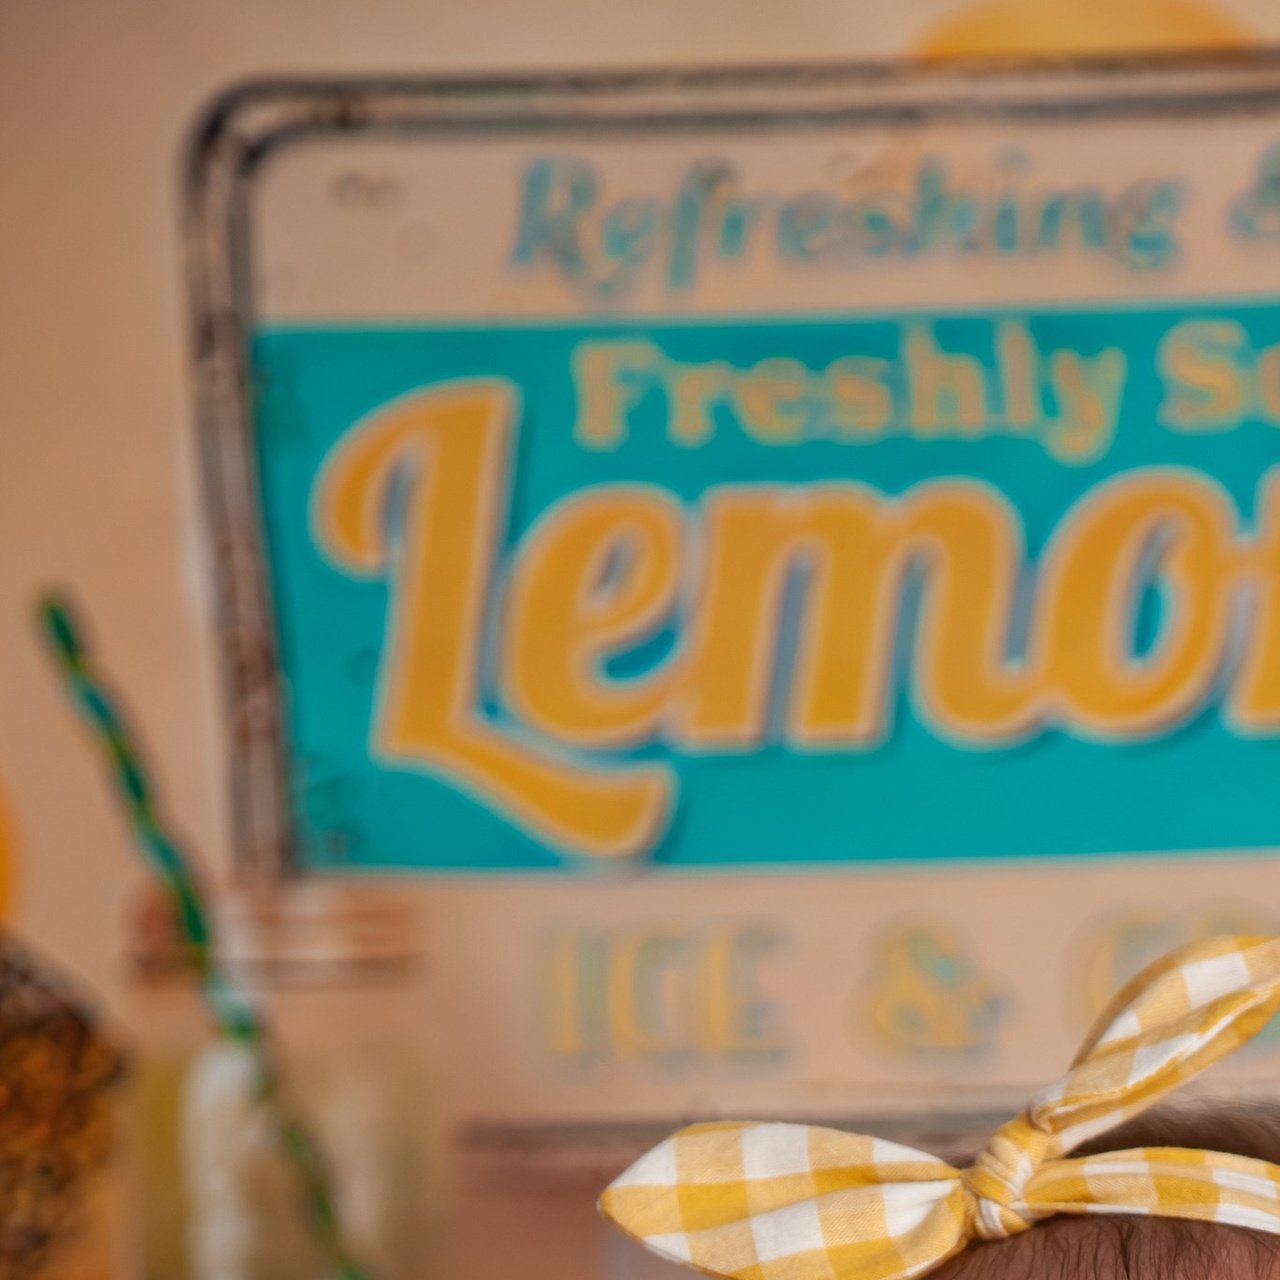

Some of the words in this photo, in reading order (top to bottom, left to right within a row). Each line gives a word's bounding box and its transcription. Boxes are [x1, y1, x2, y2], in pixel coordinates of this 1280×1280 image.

[510, 150, 1182, 302] Refreshing
[572, 316, 1128, 464] Freshly
[548, 922, 790, 1058] ICE
[866, 918, 1006, 1052] &
